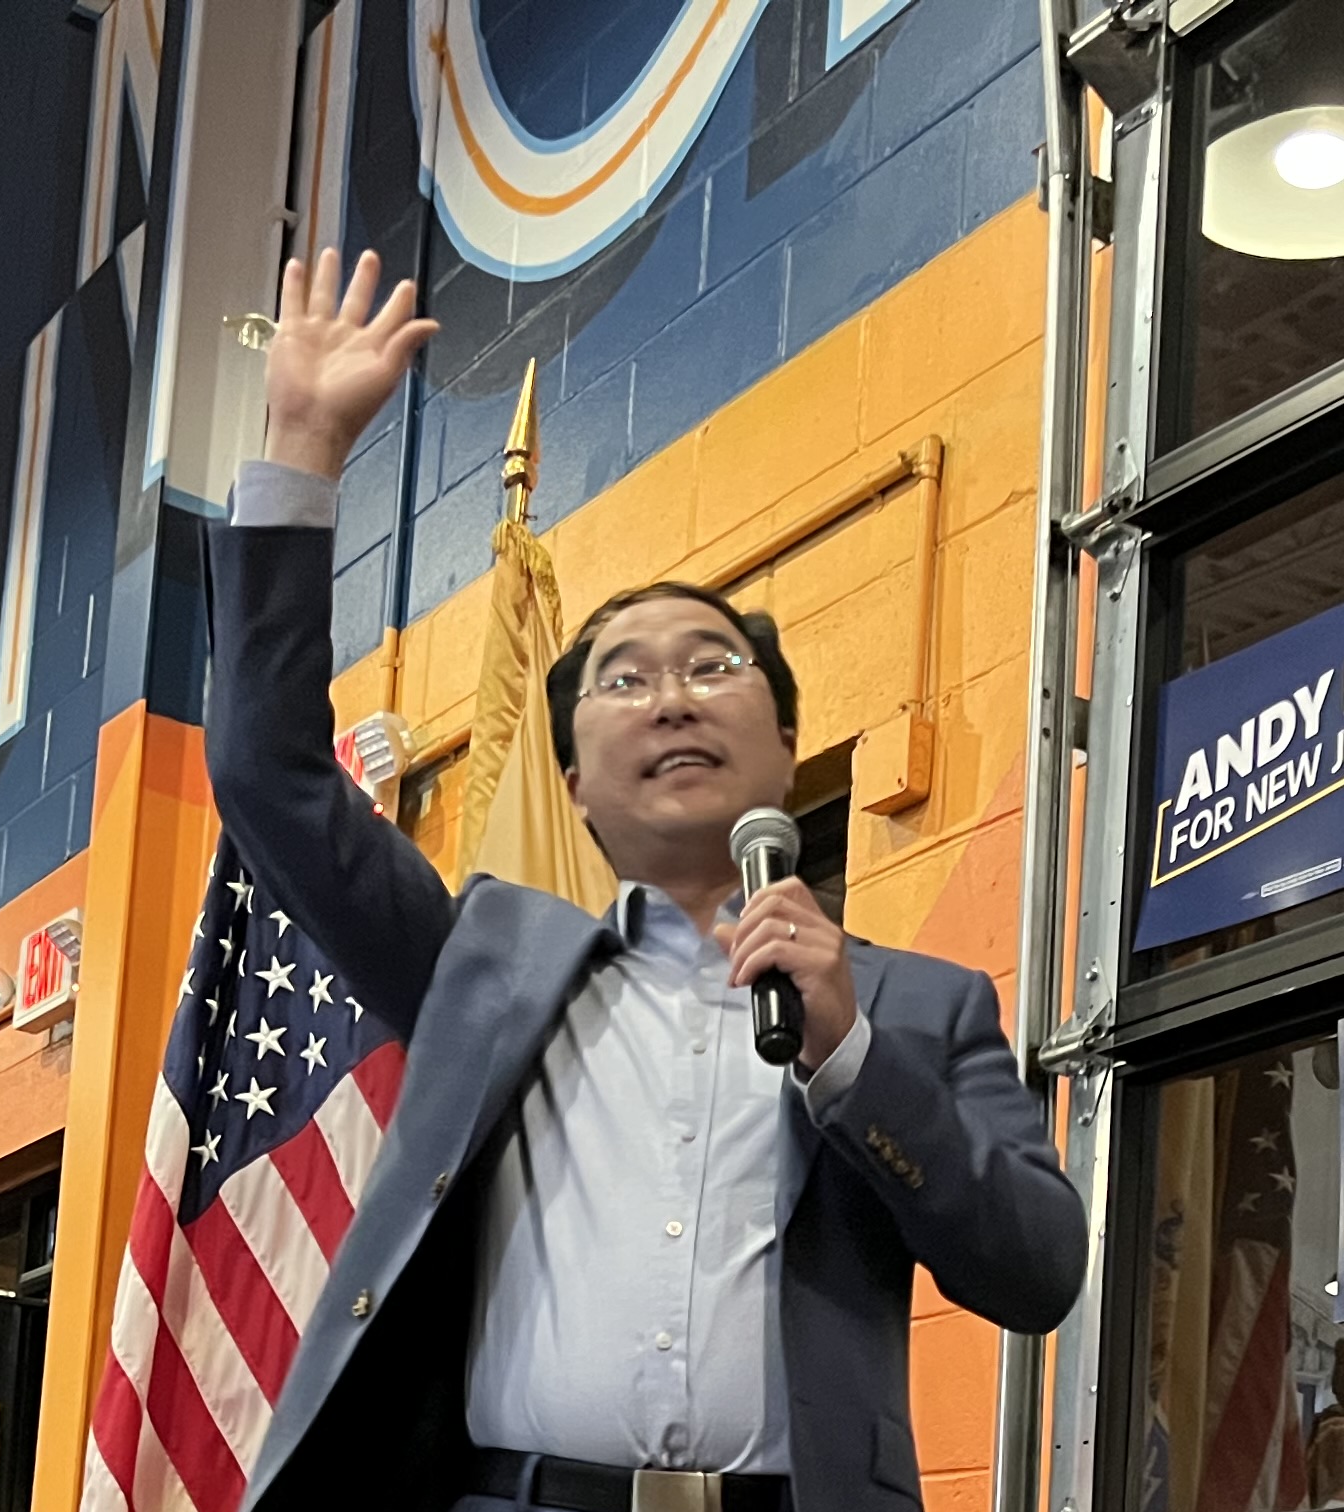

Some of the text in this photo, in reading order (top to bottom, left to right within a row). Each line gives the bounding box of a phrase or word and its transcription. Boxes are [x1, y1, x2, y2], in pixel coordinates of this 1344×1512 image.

[1169, 796, 1235, 863] FOR
[1245, 743, 1322, 822] NEW
[1174, 669, 1334, 815] ANDY
